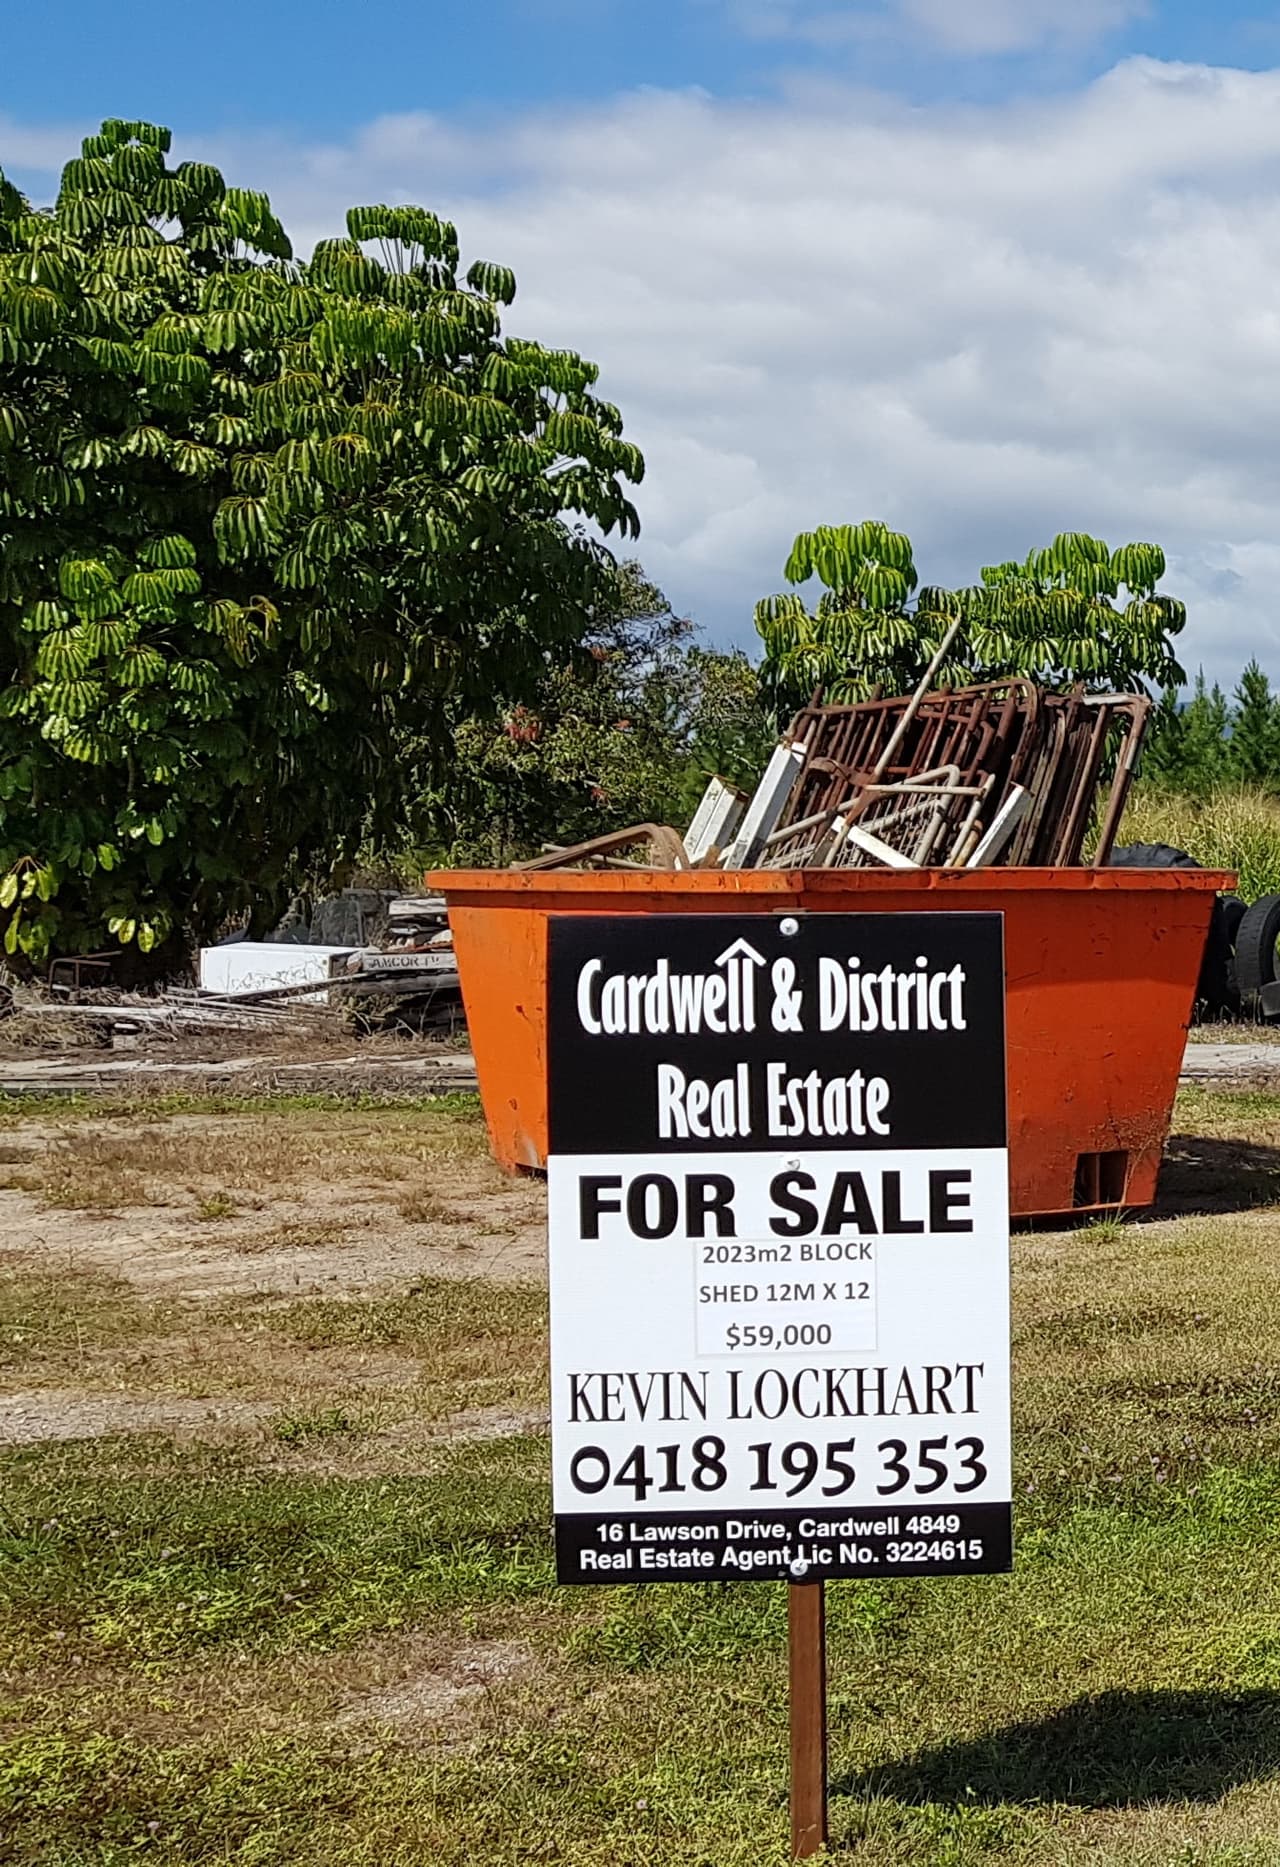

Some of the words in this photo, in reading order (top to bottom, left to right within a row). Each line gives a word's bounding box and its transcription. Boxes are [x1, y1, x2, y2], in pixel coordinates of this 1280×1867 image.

[578, 950, 762, 1034] Cardwell
[772, 957, 803, 1032] &
[820, 956, 966, 1031] District
[658, 1063, 751, 1137] Real
[767, 1063, 889, 1136] Estate
[579, 1174, 737, 1239] FOR
[769, 1170, 973, 1237] SALE
[704, 1245, 791, 1263] 2023m2
[801, 1243, 872, 1261] BLOCK
[700, 1285, 758, 1303] SHED
[768, 1284, 814, 1301] 12M
[824, 1283, 837, 1300] X
[846, 1282, 869, 1299] 12
[727, 1323, 831, 1350] $59,000
[568, 1372, 709, 1422] KEVIN
[727, 1363, 984, 1419] LOCKHART
[571, 1436, 727, 1501] 0418
[748, 1438, 855, 1497] 195
[877, 1435, 987, 1495] 353
[597, 1524, 624, 1542] 16
[630, 1523, 718, 1541] Lawson
[727, 1520, 791, 1541] Drive,
[799, 1517, 899, 1538] Cardwell
[906, 1515, 960, 1534] 4849
[581, 1549, 632, 1569] Real
[639, 1547, 715, 1568] Estate
[721, 1546, 790, 1571] Agent
[797, 1545, 832, 1565] Lic
[840, 1544, 878, 1564] No.
[886, 1540, 983, 1562] 3224615
